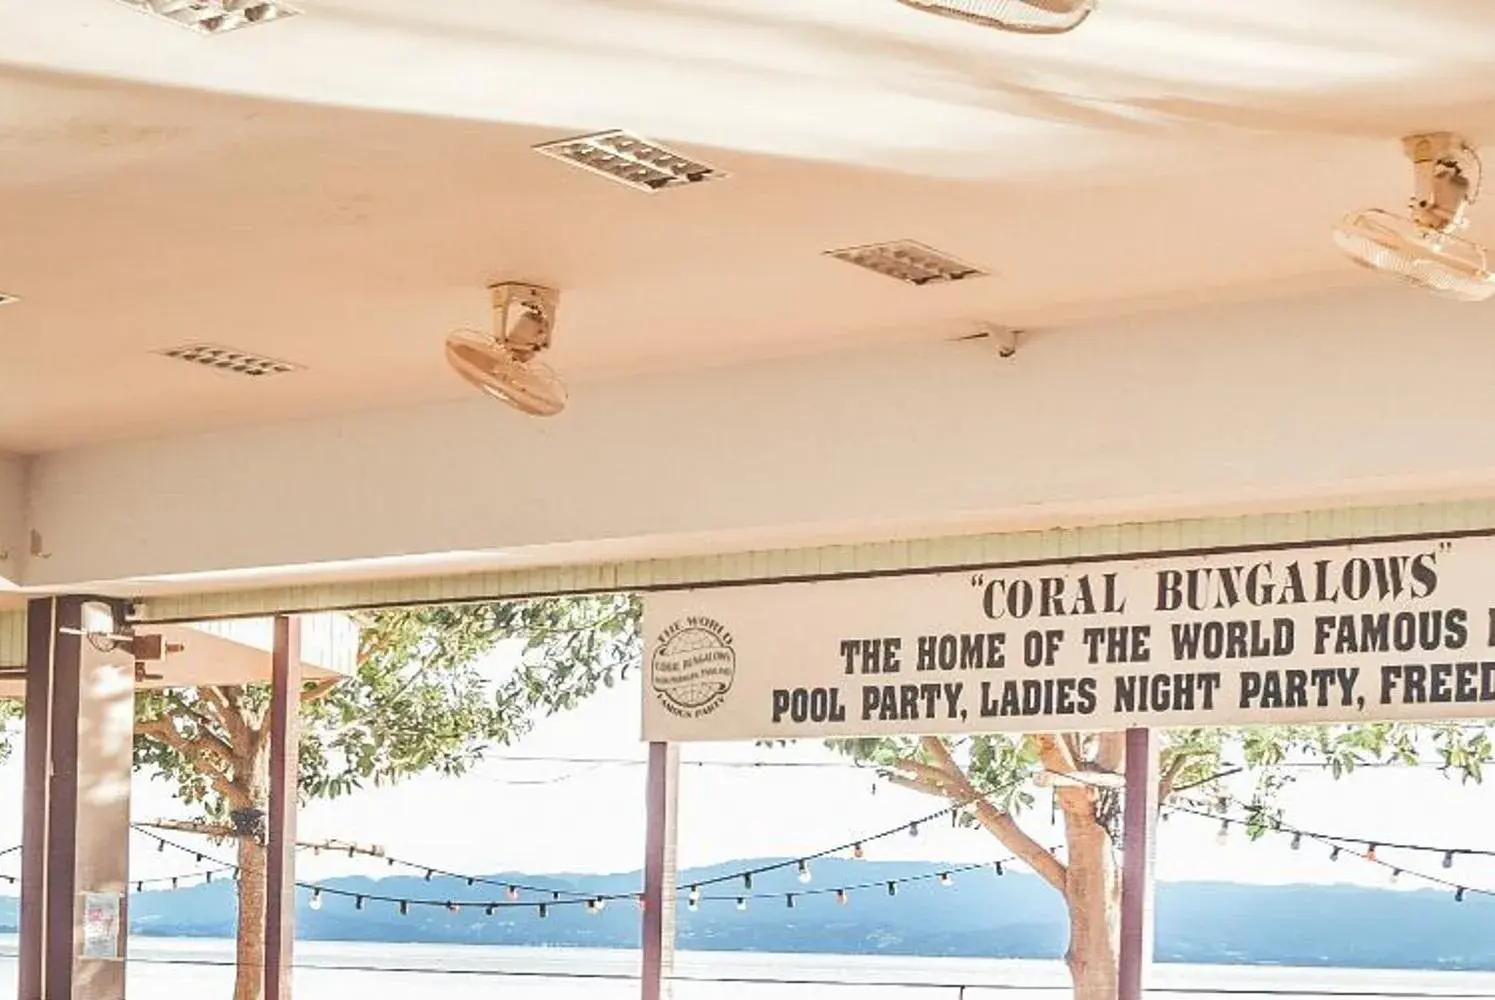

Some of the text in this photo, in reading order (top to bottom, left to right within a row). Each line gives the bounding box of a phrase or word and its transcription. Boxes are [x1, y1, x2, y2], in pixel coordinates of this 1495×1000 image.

[840, 637, 901, 674] THE
[916, 632, 1006, 671] HOME
[1024, 629, 1064, 667] OF
[1083, 625, 1151, 664] THE
[1171, 617, 1295, 660] WORLD
[1314, 608, 1467, 654] FAMOUS
[772, 661, 1495, 724] POOL PARTY, LADIES NIGHT PARTY, FREED
